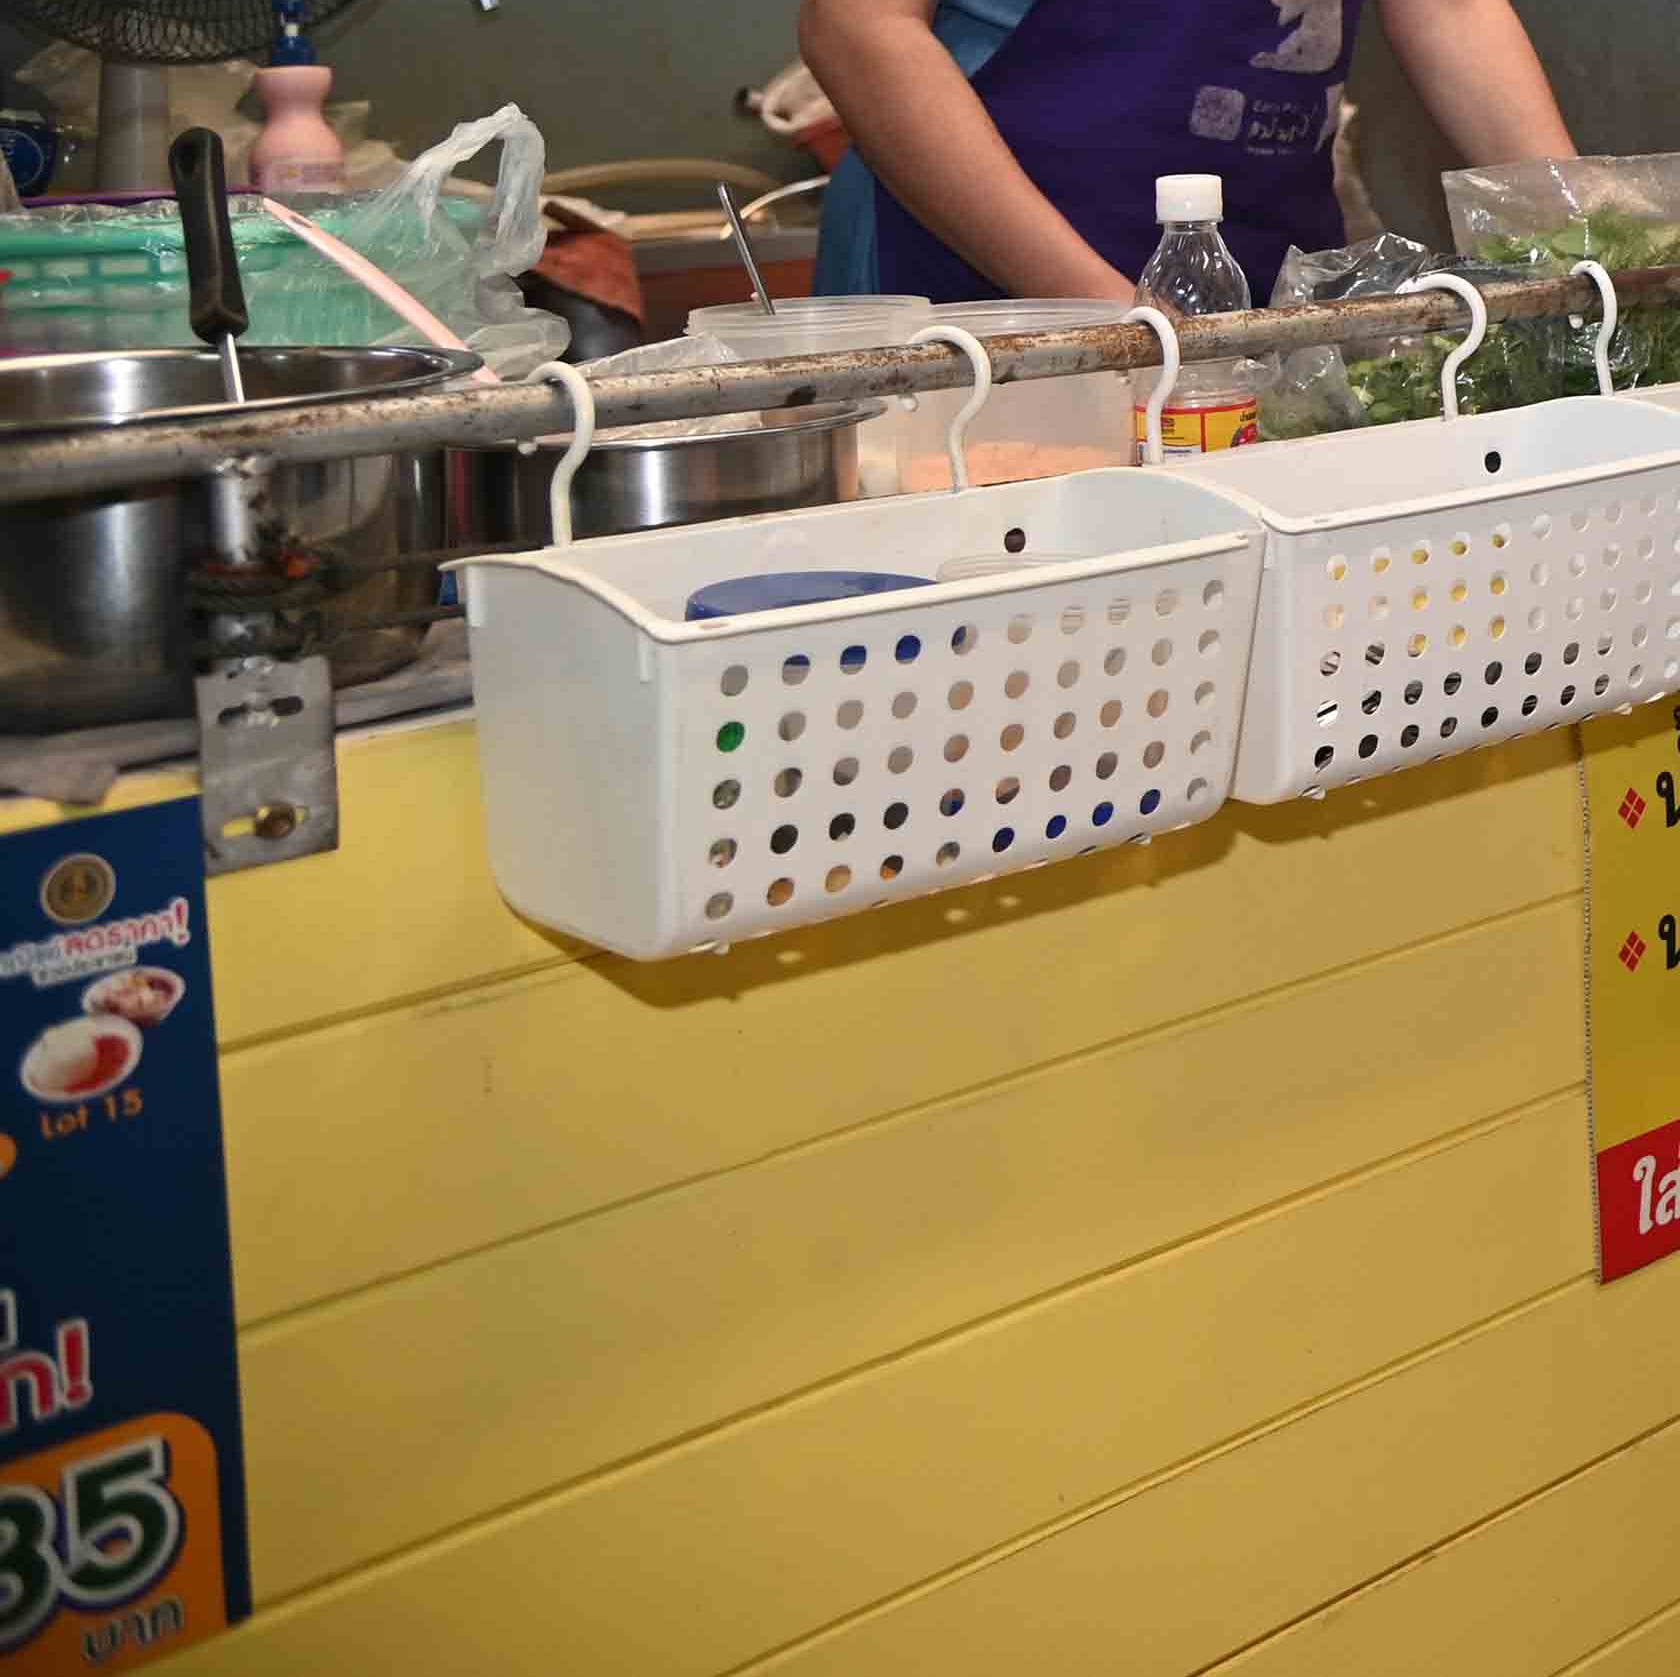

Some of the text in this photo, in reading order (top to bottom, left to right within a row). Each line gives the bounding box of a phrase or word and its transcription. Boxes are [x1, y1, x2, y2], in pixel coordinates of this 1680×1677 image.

[40, 1088, 144, 1140] Lot 15
[81, 1595, 186, 1666] บาท
